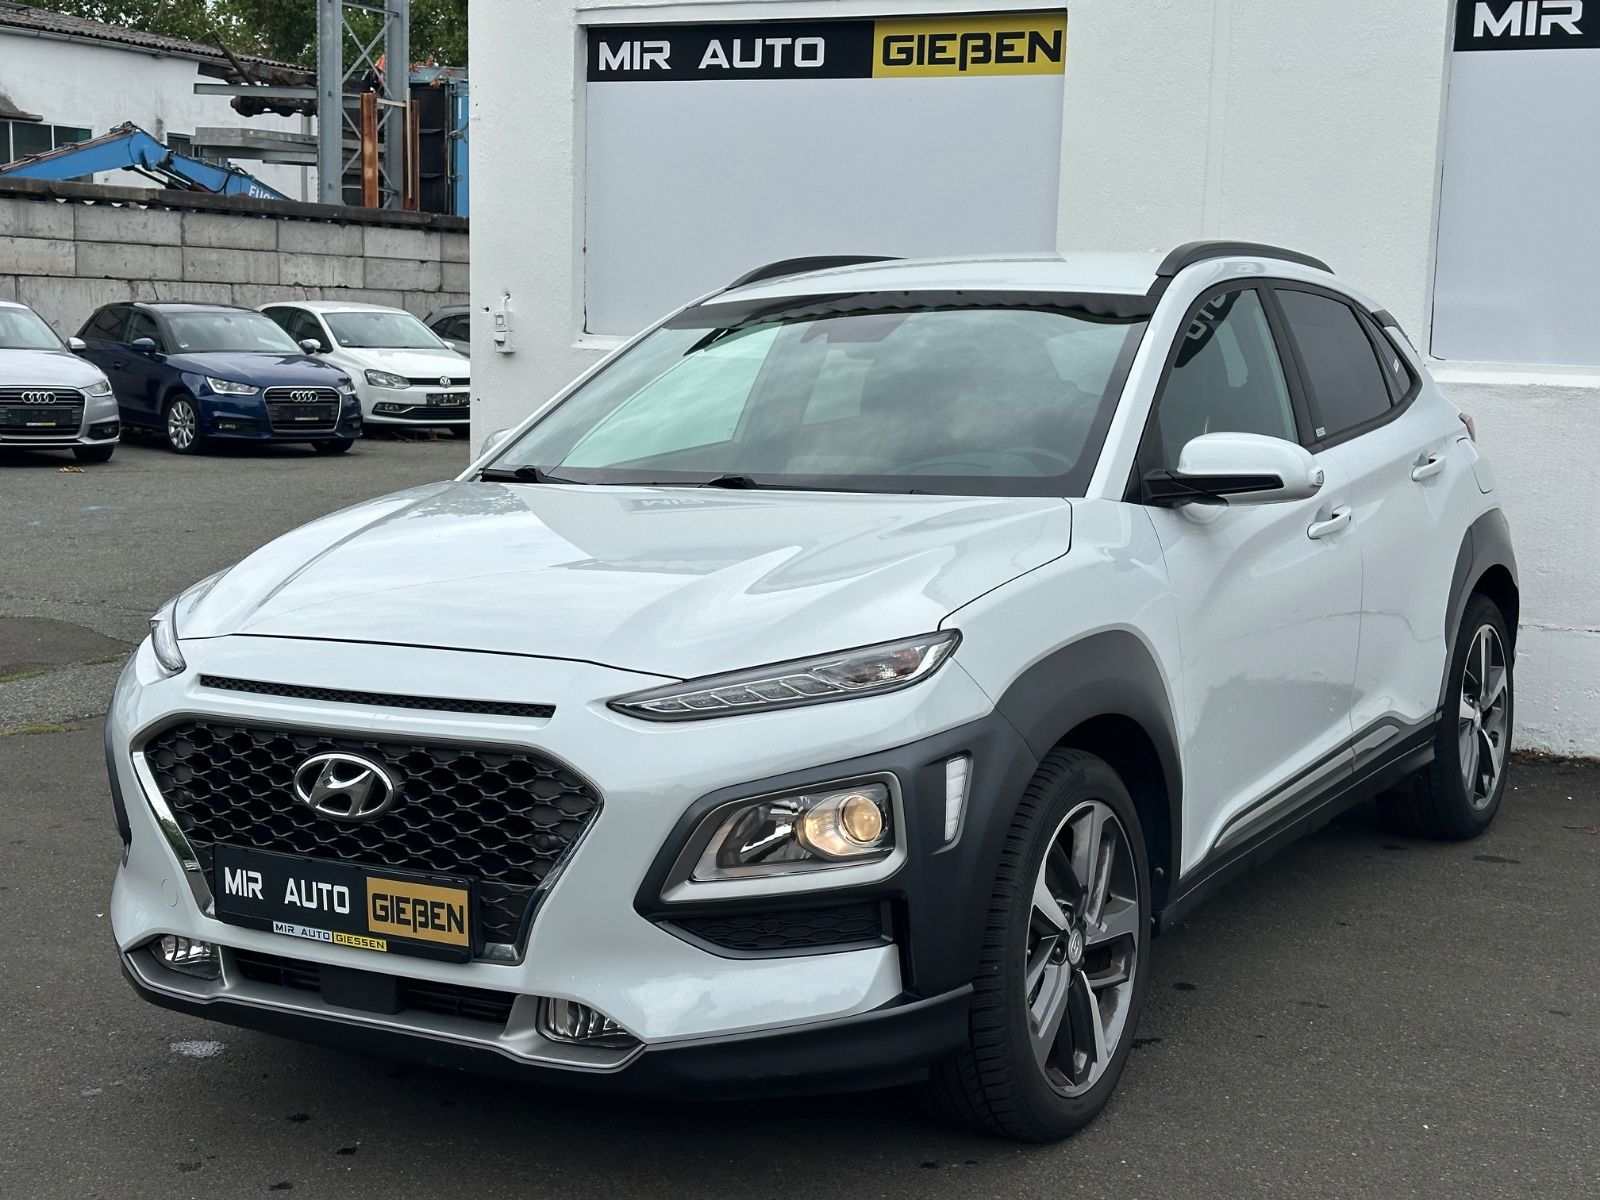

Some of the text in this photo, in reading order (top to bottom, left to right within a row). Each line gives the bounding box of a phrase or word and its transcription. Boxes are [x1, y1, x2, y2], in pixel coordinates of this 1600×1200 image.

[1473, 0, 1583, 37] MIR
[598, 40, 672, 71] MIR
[698, 37, 825, 69] AUTO
[224, 866, 264, 900] MIR
[284, 877, 350, 914] AUTO
[275, 923, 385, 949] MIR AUTO GIESSEN
